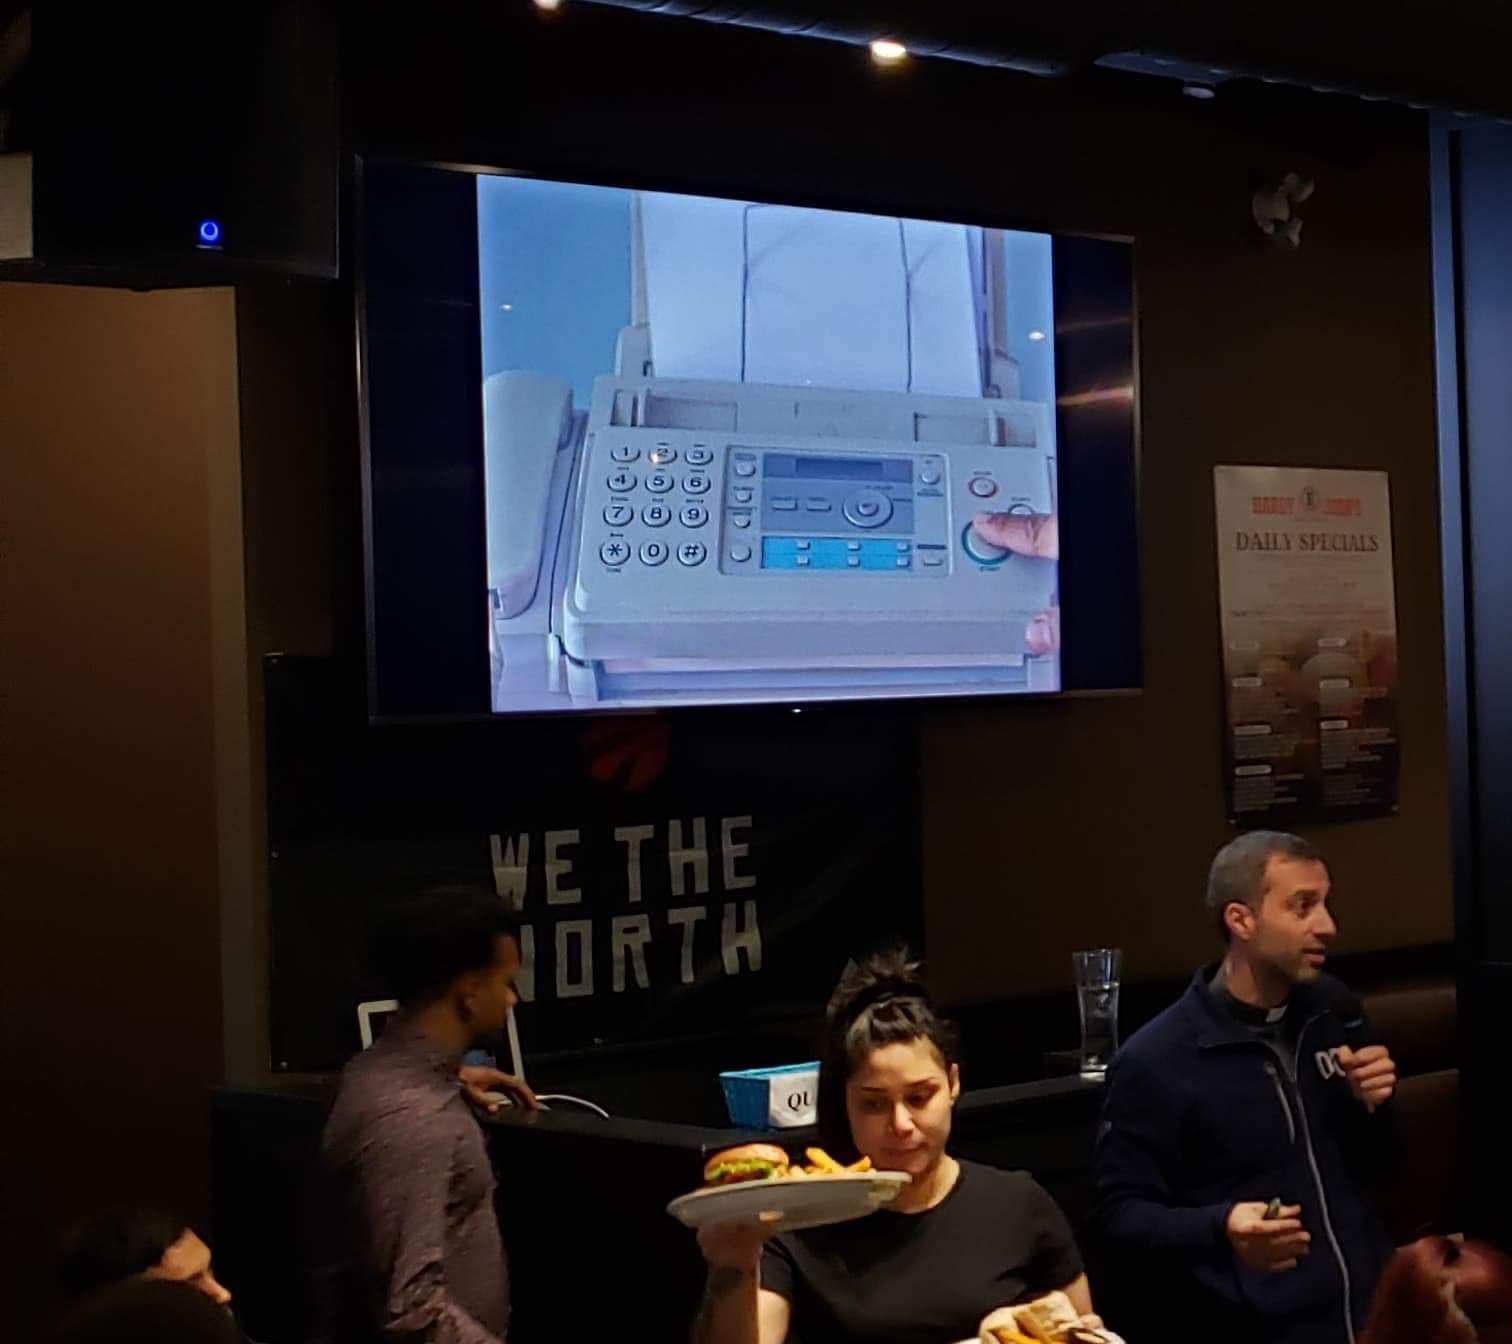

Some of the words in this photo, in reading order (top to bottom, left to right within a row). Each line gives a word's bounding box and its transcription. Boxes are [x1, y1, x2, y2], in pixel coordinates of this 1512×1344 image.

[1236, 531, 1292, 552] DAILY
[1299, 533, 1379, 553] SPECIALS
[489, 828, 582, 912] WE
[614, 814, 757, 904] THE
